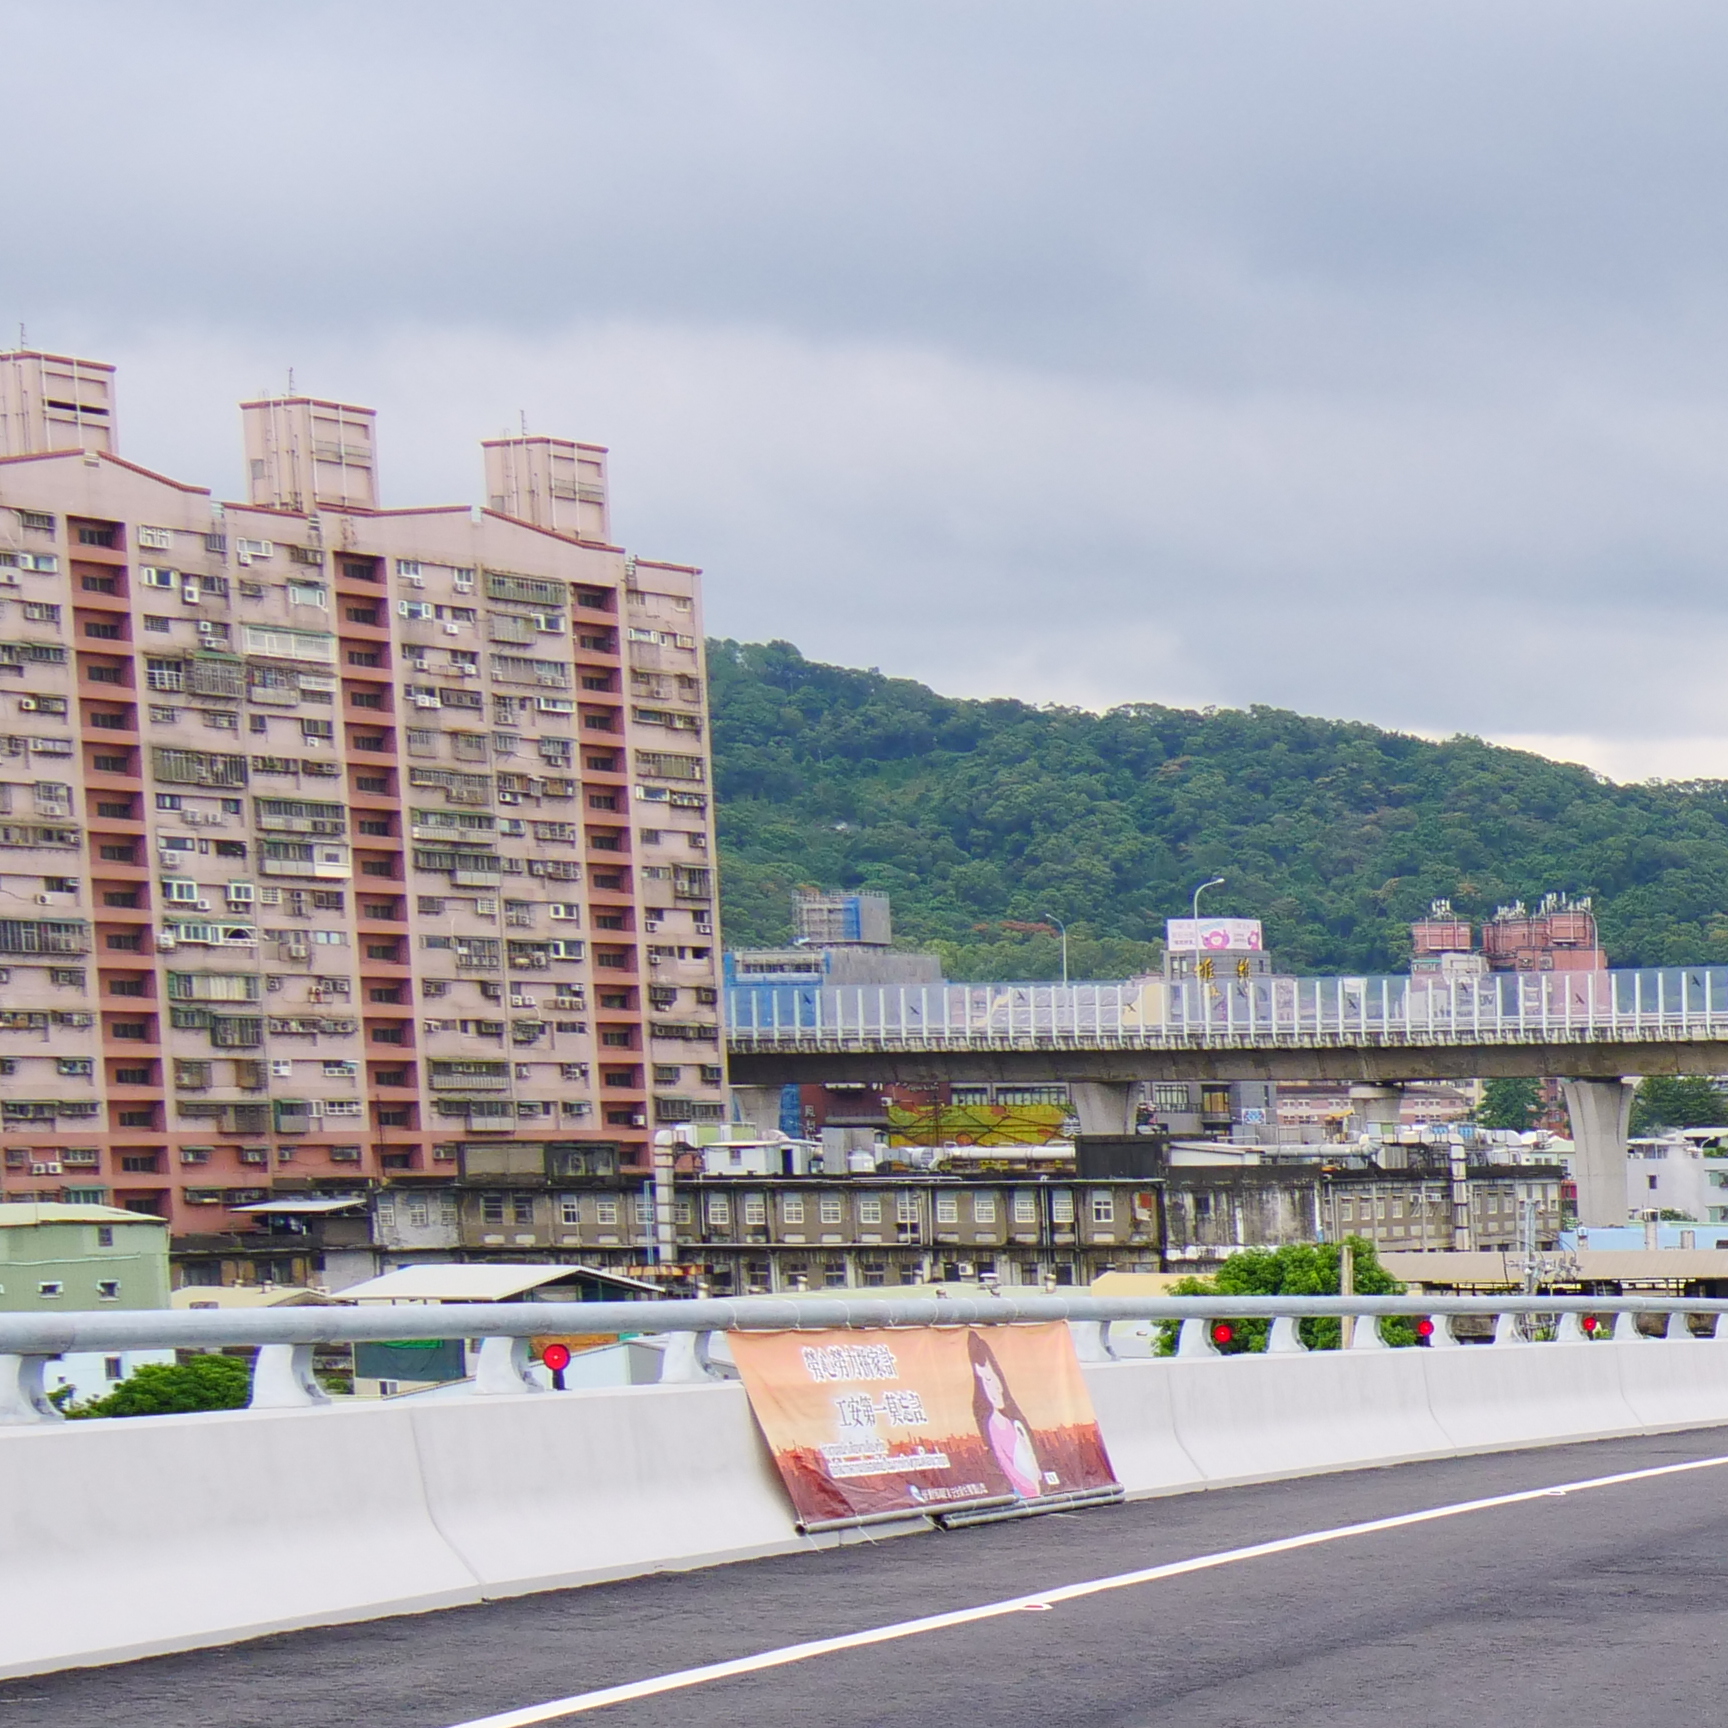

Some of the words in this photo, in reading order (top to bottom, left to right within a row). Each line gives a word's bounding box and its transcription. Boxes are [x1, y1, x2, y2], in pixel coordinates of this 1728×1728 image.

[836, 1393, 928, 1428] 工安第一莫忘記
